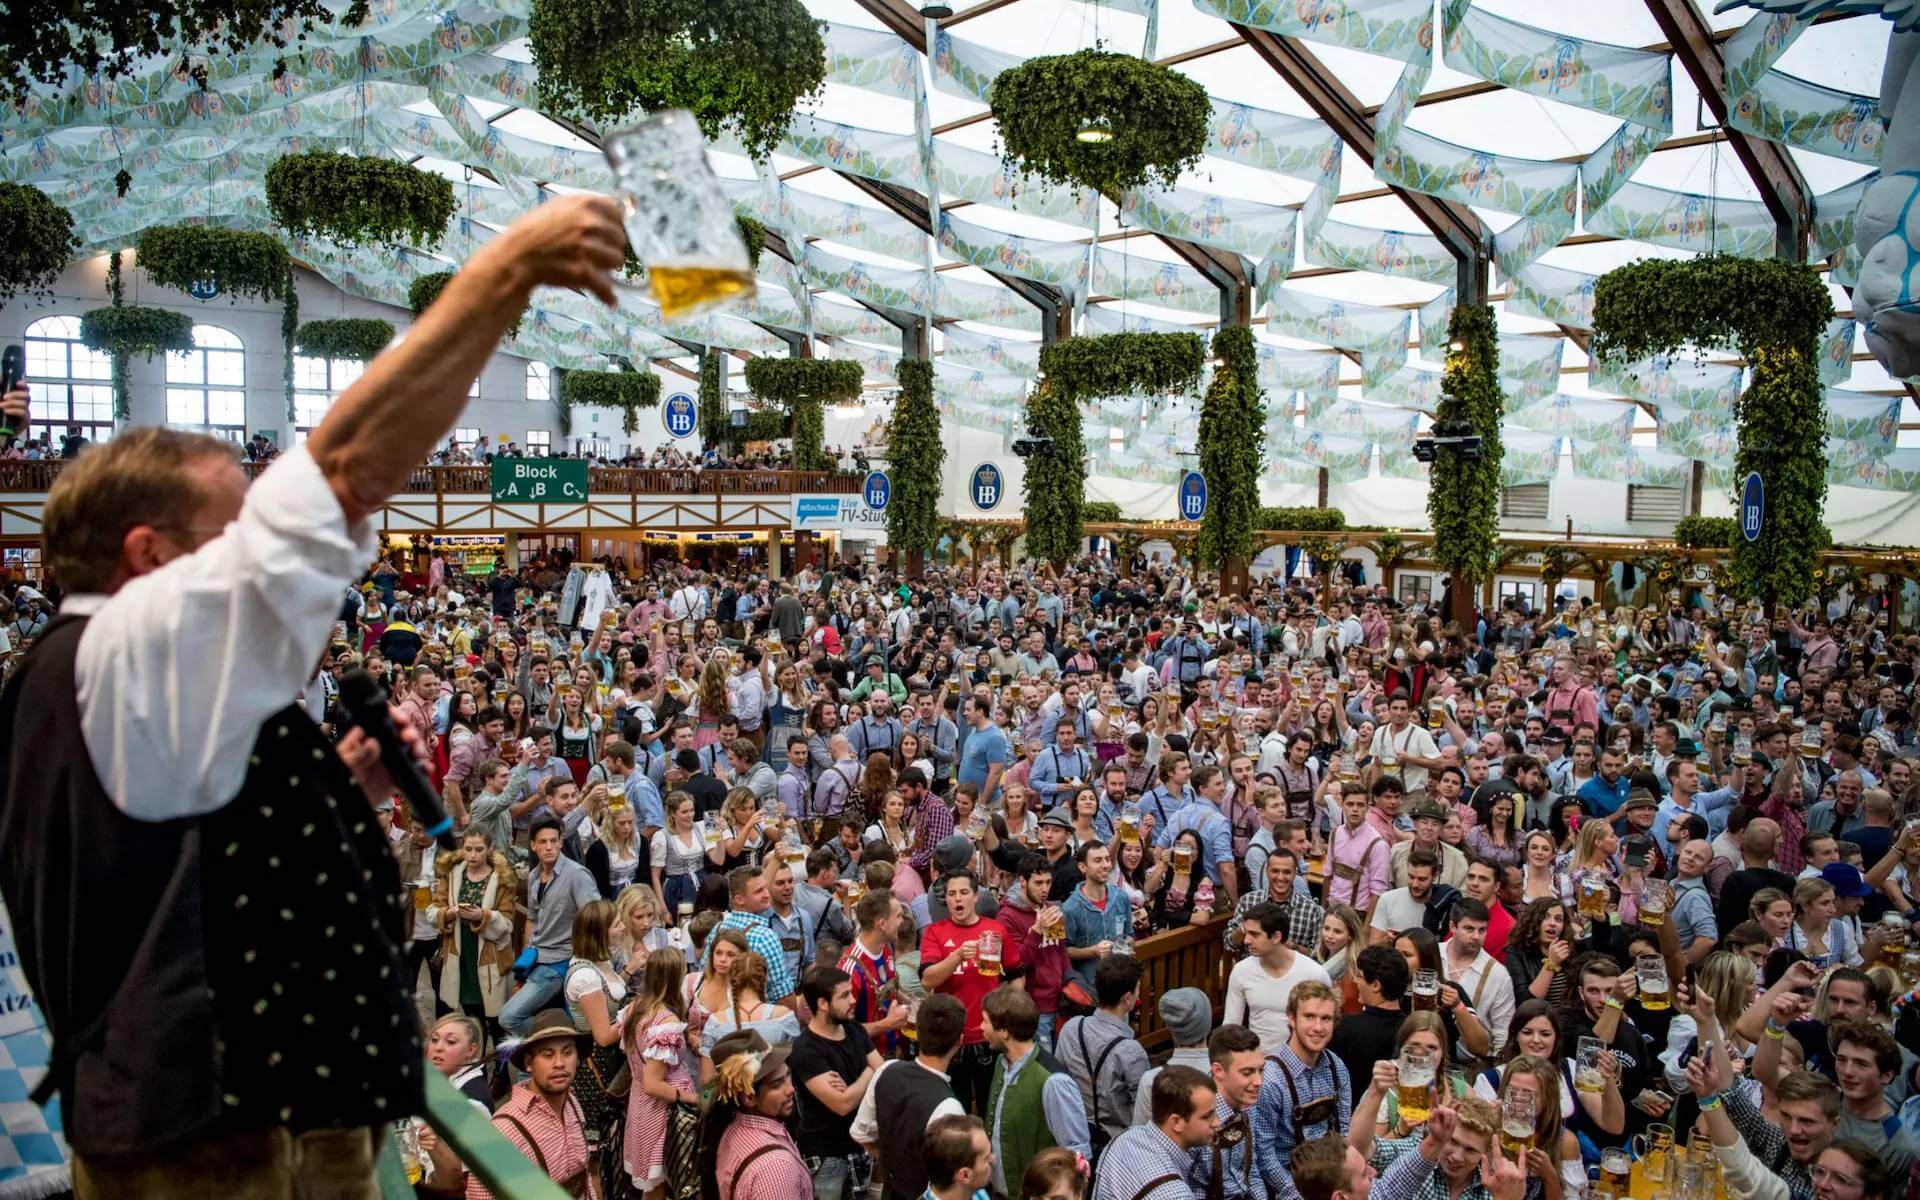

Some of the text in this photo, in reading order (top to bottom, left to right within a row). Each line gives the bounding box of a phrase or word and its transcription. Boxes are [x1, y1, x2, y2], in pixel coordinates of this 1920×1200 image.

[672, 414, 690, 430] HB
[515, 464, 557, 479] Block
[507, 482, 574, 496] A B C
[978, 485, 996, 504] HB
[841, 499, 858, 508] Live
[870, 490, 885, 505] HB
[1186, 495, 1202, 514] HB
[1746, 505, 1759, 530] HB
